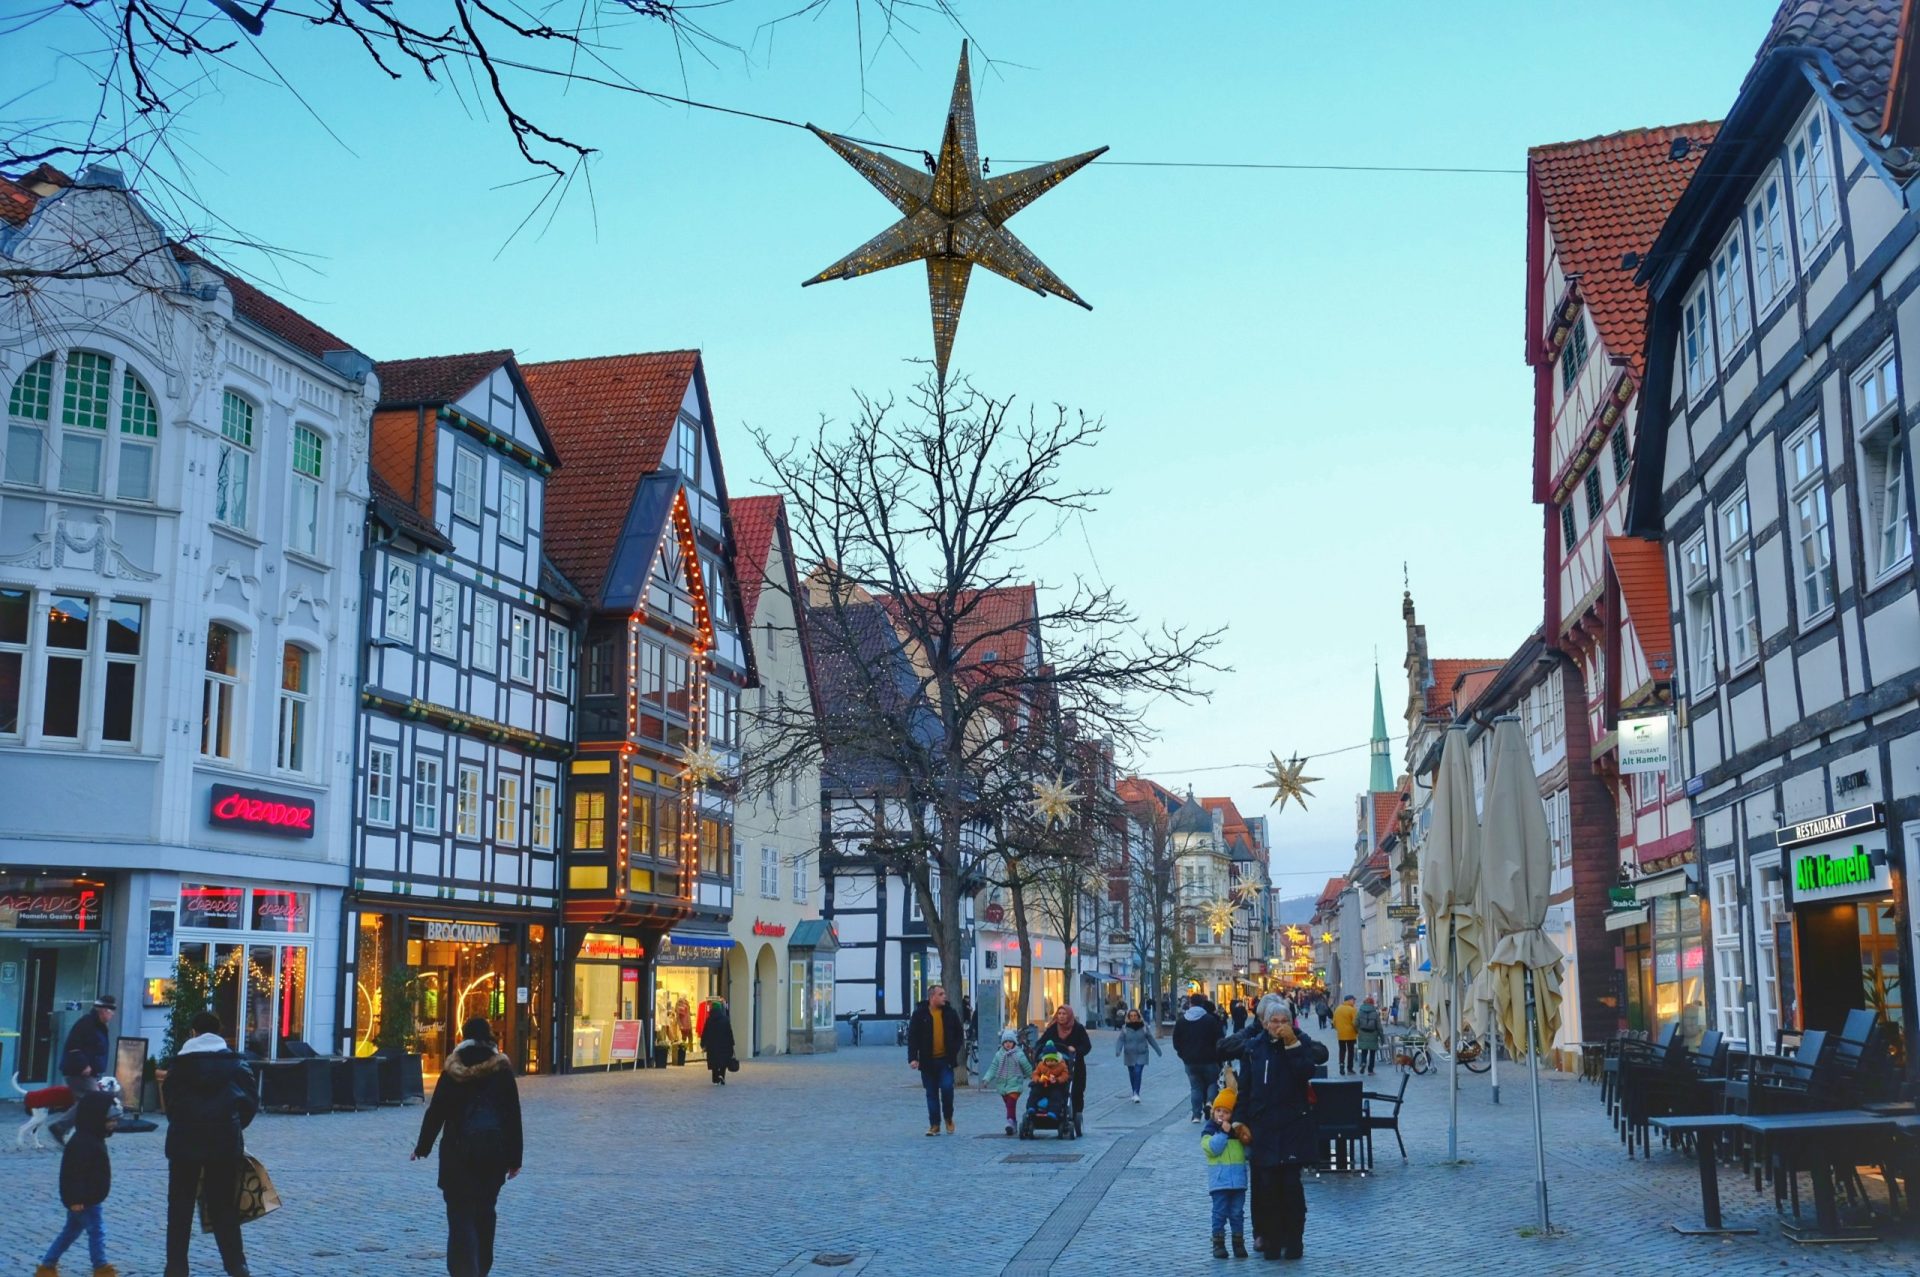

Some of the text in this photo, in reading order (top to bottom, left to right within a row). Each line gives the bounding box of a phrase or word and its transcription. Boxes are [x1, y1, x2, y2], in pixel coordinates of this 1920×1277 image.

[1622, 754, 1667, 766] Alt Hameln
[1629, 747, 1660, 755] RESTAURANT
[214, 793, 312, 829] CAZADOR
[1795, 814, 1847, 839] RESTAURANT
[1796, 845, 1870, 890] Alt Hameln
[187, 896, 239, 912] CAZADOR
[427, 922, 500, 943] BROCKMANN
